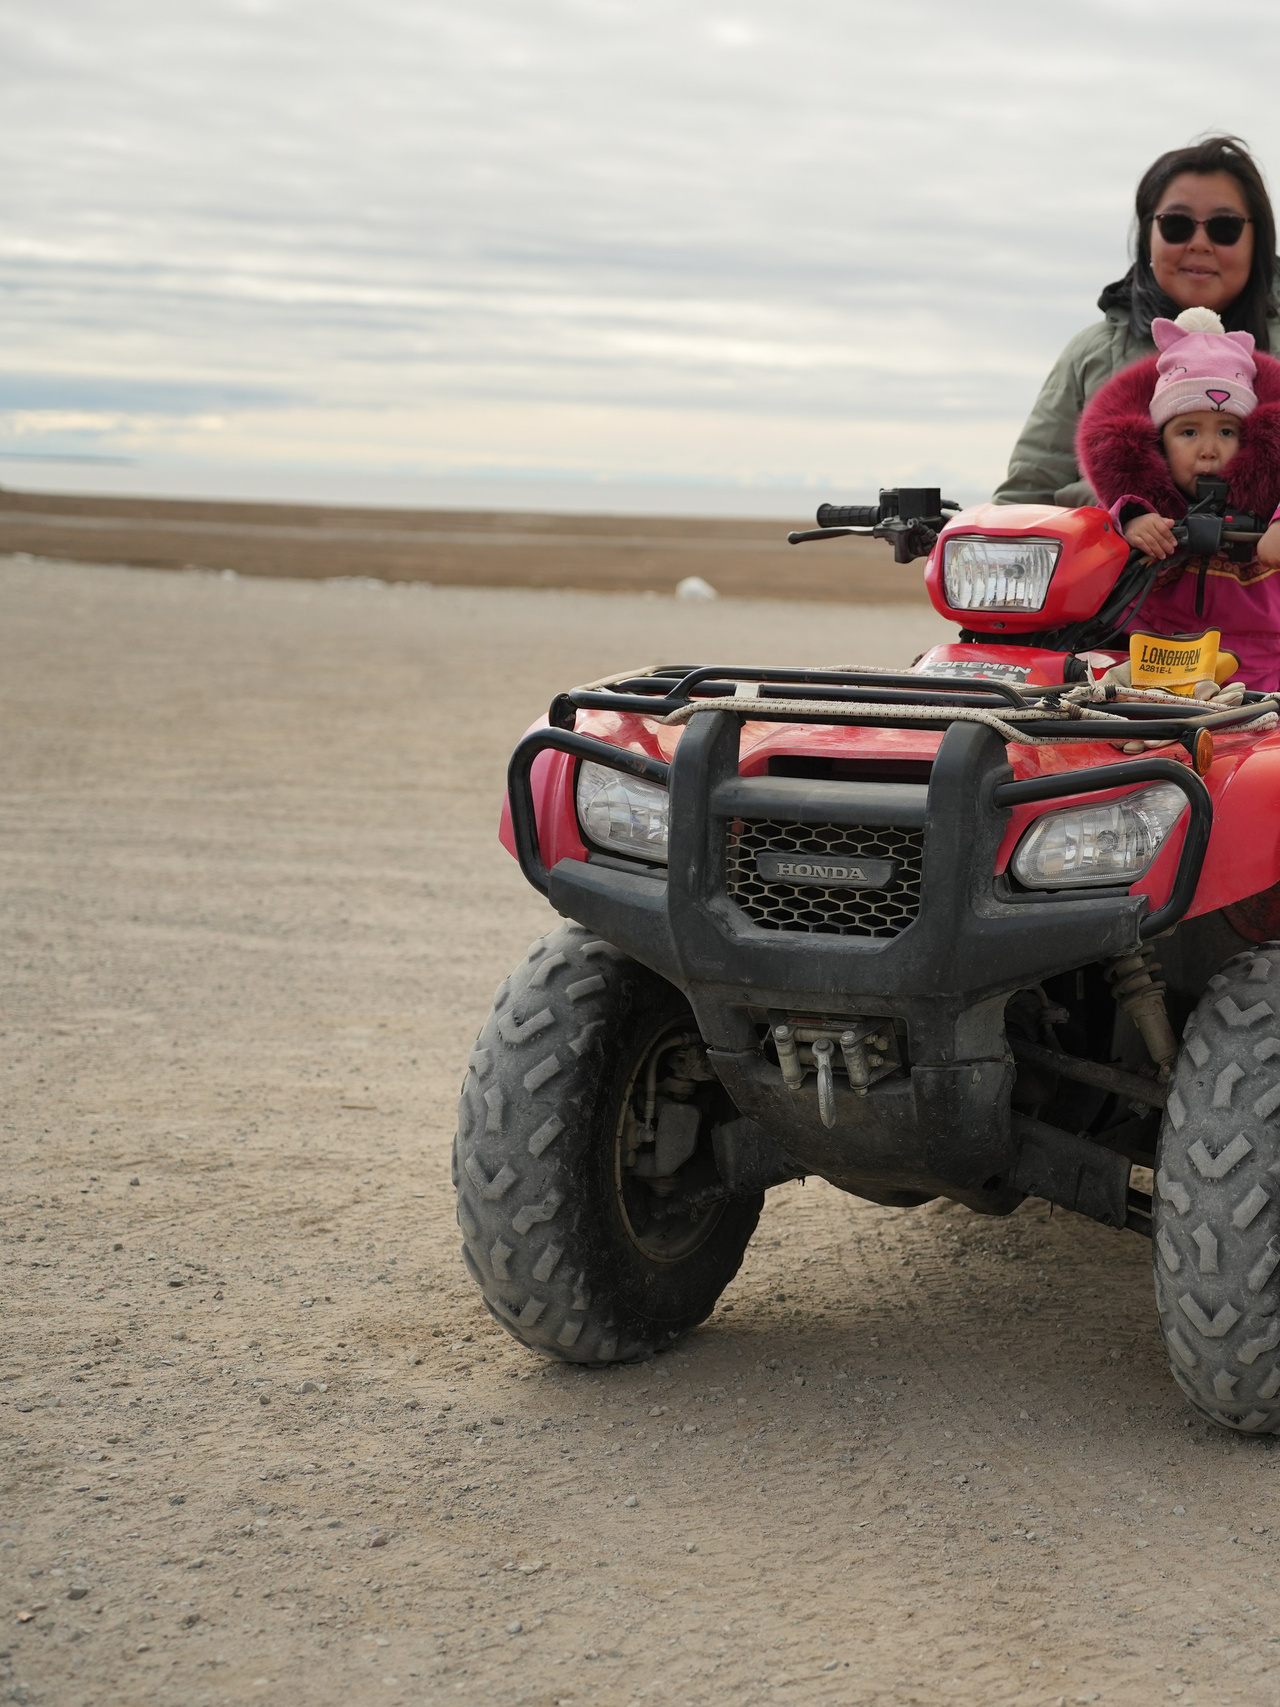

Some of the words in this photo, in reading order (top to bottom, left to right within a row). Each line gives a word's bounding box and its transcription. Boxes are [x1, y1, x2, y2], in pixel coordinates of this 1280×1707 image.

[1140, 644, 1202, 667] LONGHORN
[1138, 663, 1173, 674] A281E-L
[776, 862, 868, 881] HONDA
